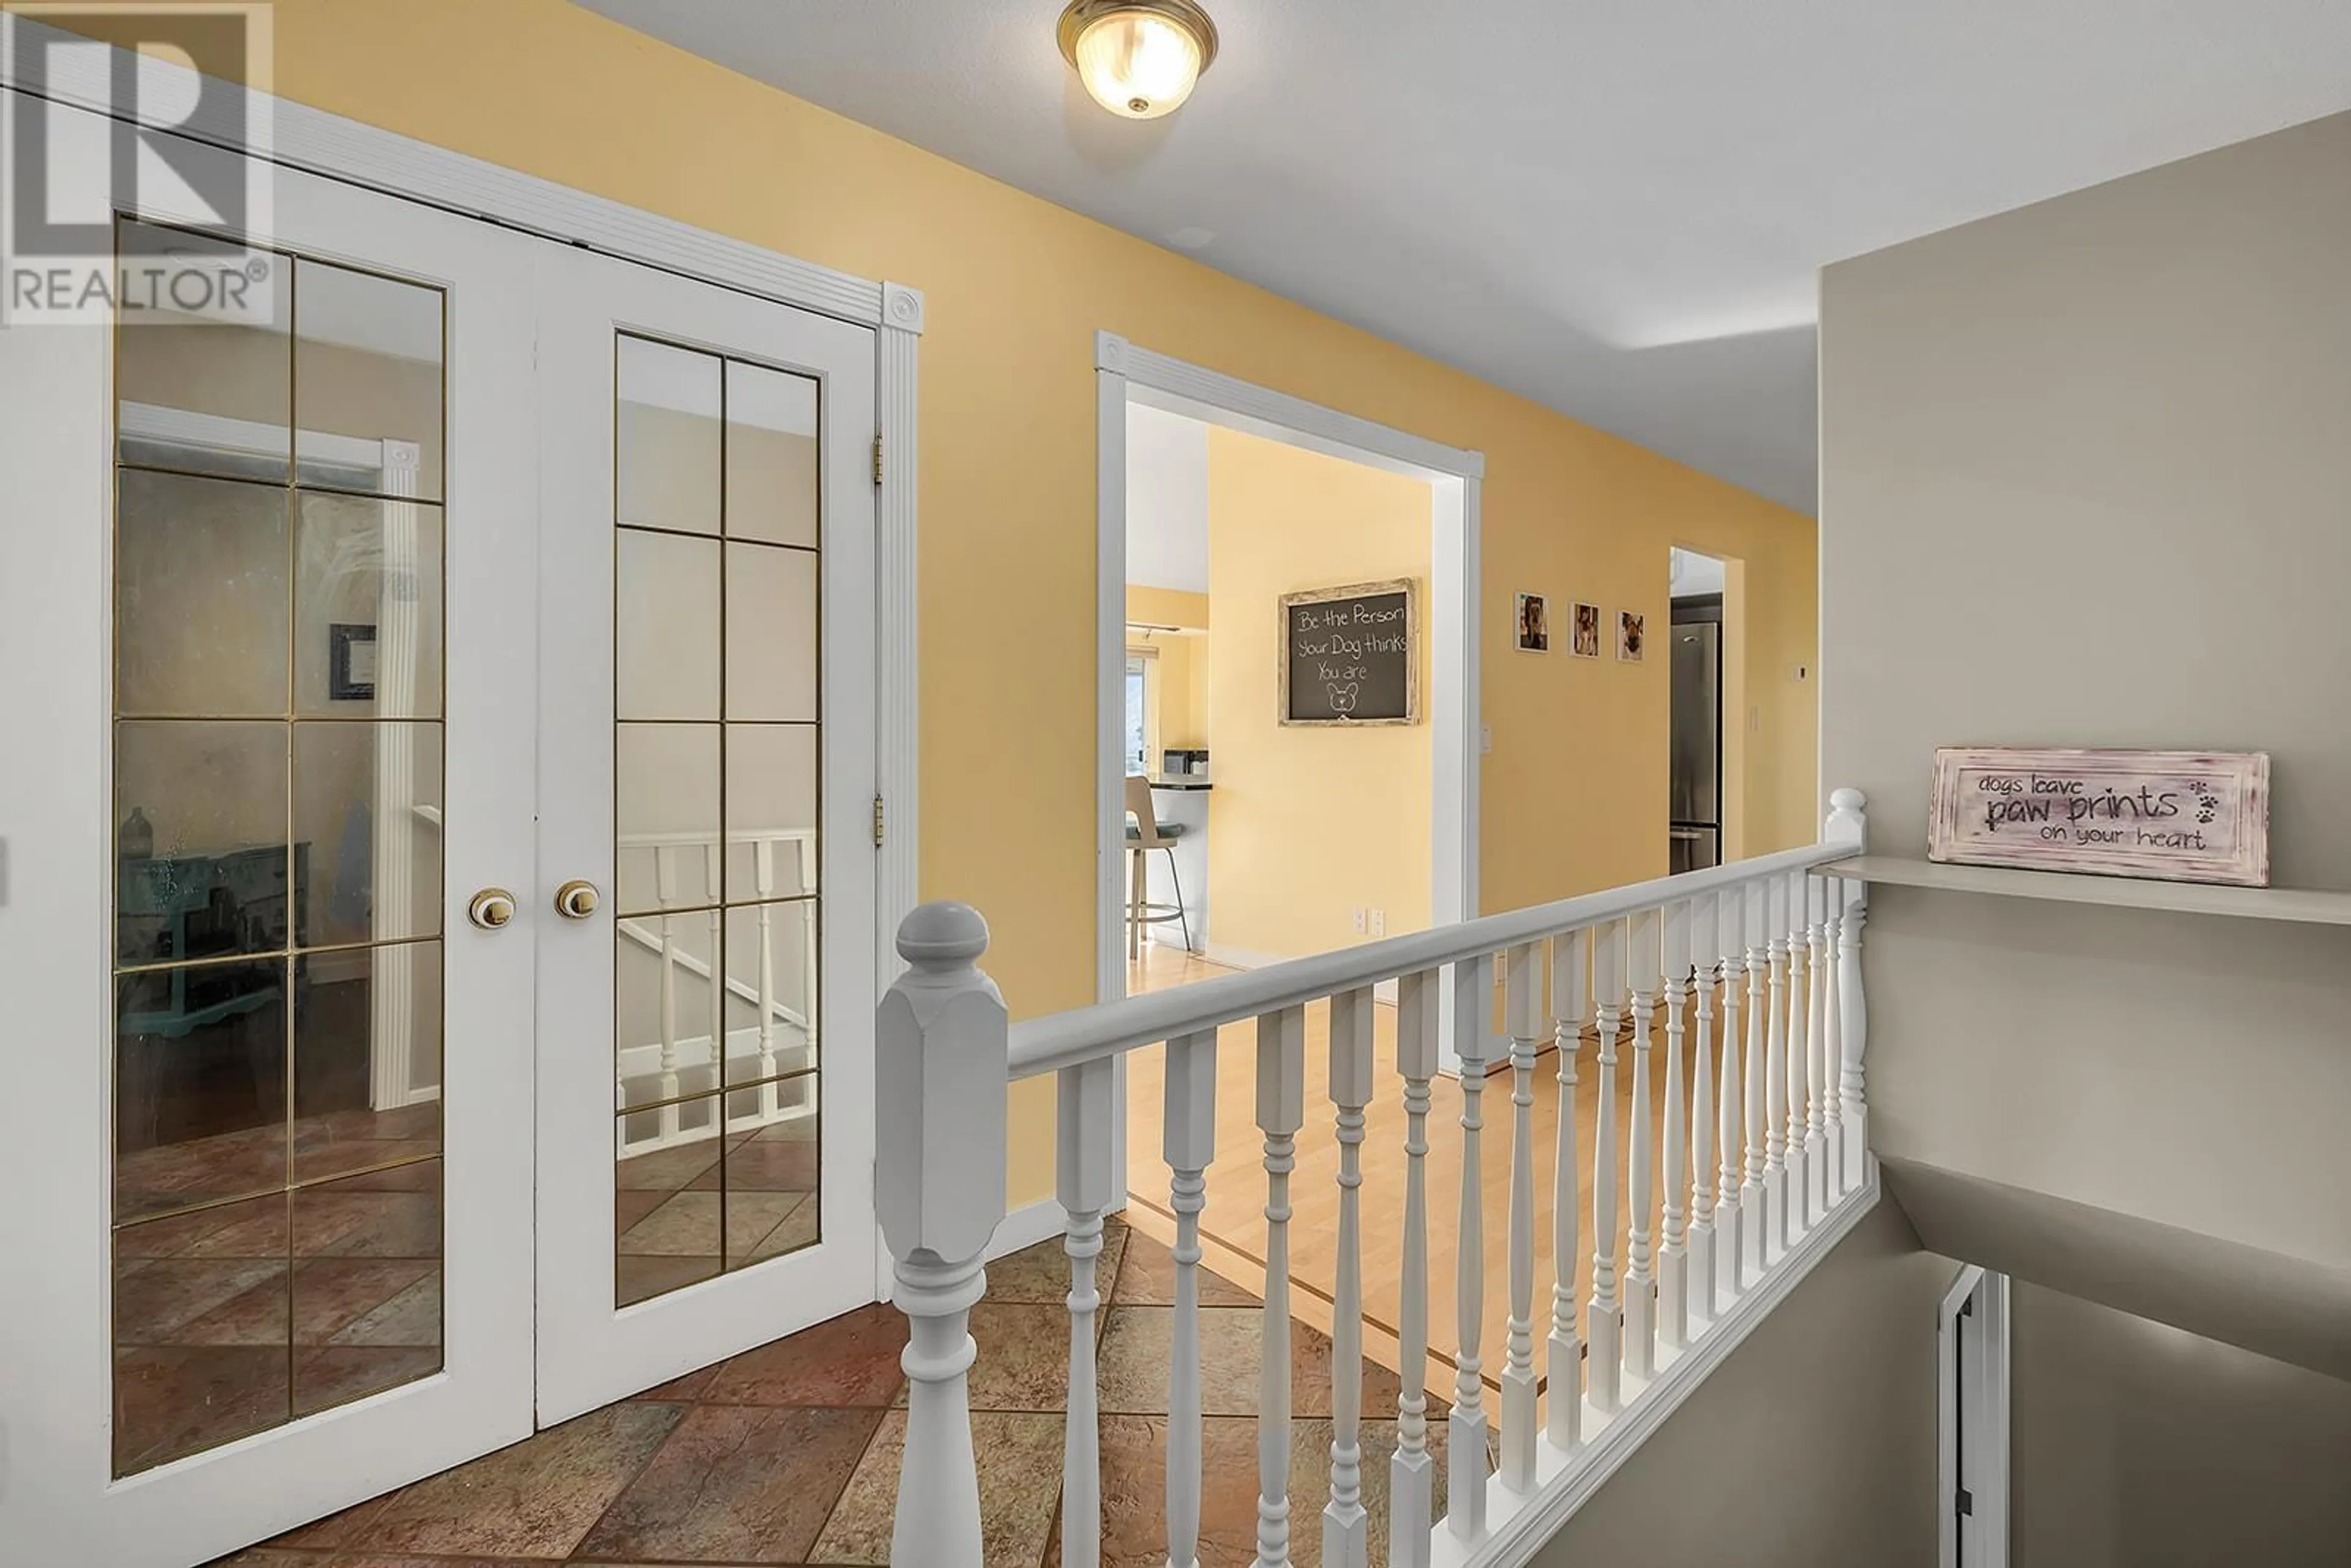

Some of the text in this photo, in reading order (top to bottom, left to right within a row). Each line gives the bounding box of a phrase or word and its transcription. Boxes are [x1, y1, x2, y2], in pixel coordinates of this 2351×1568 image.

[1297, 604, 1404, 631] Be the Person
[1330, 634, 1362, 660] Dog
[1364, 633, 1406, 653] thinks
[1318, 660, 1367, 681] You are
[1978, 774, 2083, 795] dogs leave
[1984, 785, 2179, 831] paw prints
[2040, 826, 2206, 850] on your heart
